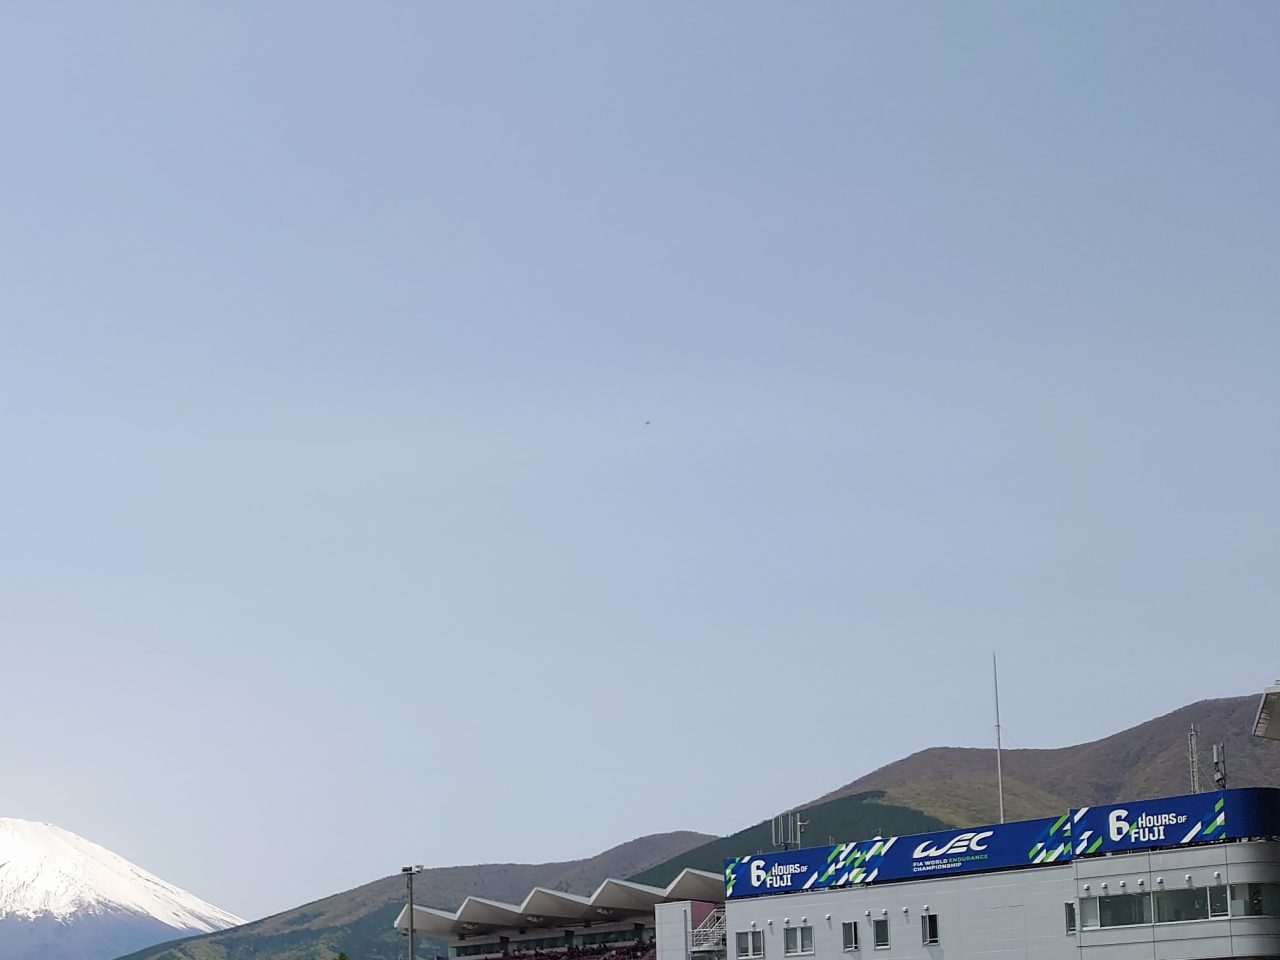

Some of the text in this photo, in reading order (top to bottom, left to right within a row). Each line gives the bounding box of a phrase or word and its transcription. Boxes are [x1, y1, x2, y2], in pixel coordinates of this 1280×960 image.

[1109, 809, 1188, 842] 6 HOURS OF
[1131, 826, 1166, 843] FUJI
[912, 830, 994, 859] WEC
[913, 862, 962, 872] CHAMPIONSHIP
[948, 854, 989, 863] ENDURANCE
[750, 860, 809, 887] 6 HOURS OF
[766, 875, 792, 888] FUJI
